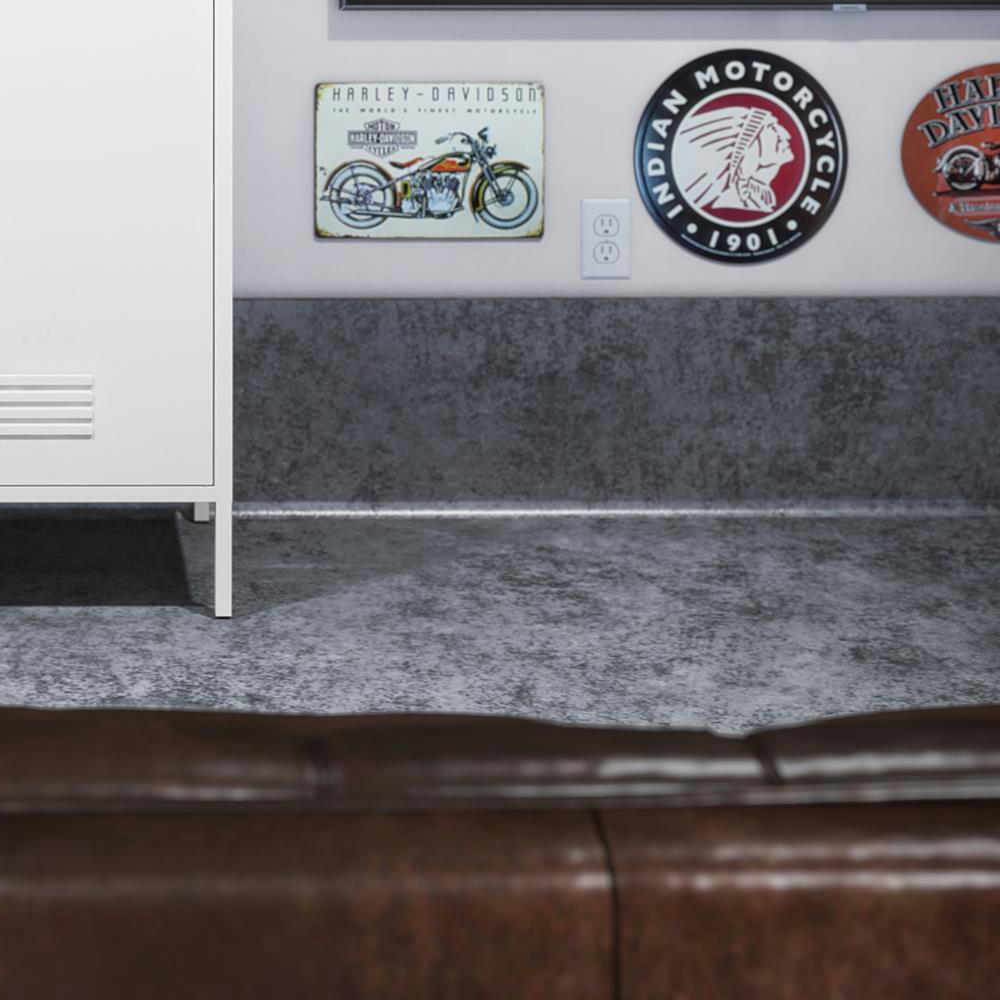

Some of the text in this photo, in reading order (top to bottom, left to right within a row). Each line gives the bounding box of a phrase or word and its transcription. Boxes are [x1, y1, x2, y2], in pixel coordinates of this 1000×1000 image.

[332, 86, 537, 102] HARLEY-DAVIDSON
[647, 60, 836, 219] INDIAN MOTORCYCLE
[709, 228, 778, 251] 1901
